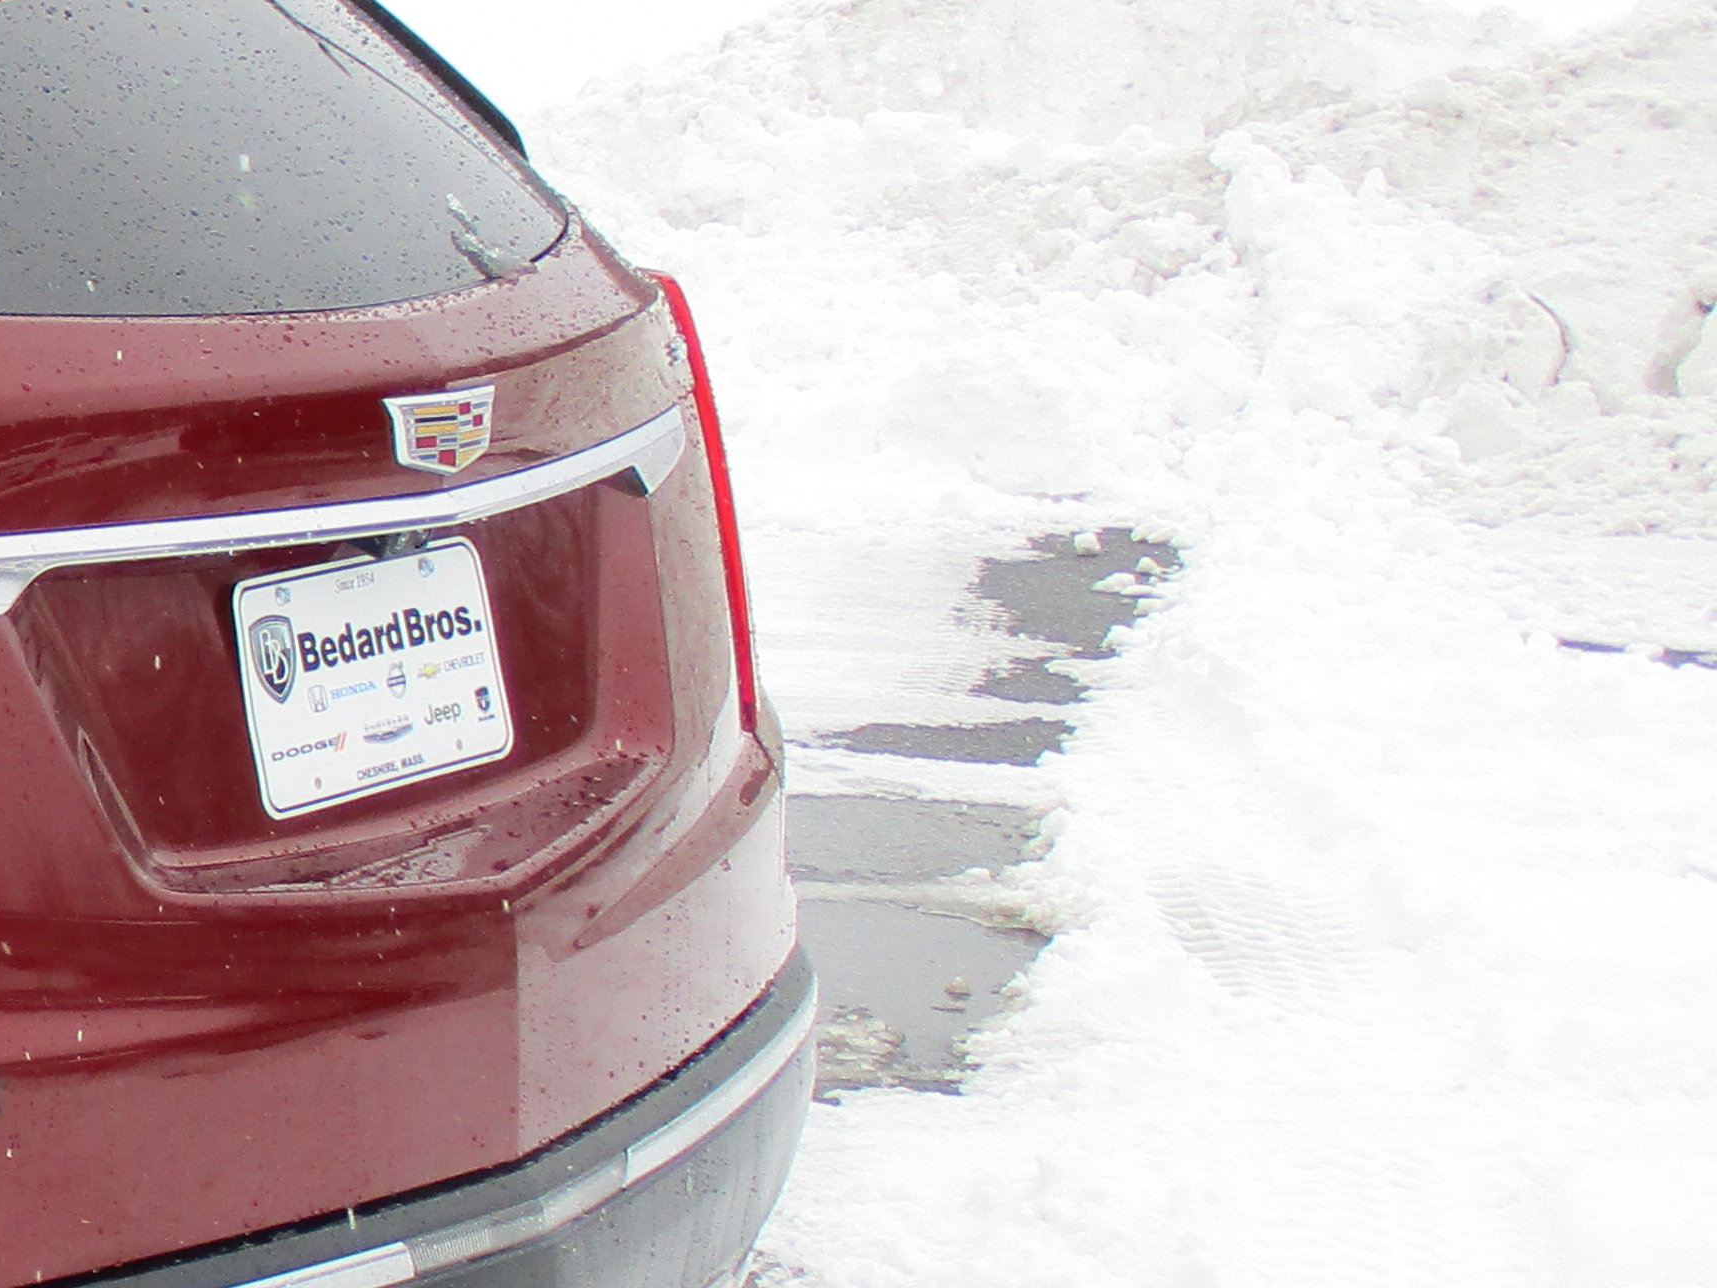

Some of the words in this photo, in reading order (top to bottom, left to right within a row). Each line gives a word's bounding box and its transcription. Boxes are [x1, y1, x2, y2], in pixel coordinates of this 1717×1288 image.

[296, 611, 405, 673] Bedard
[402, 606, 483, 648] Bros.
[330, 680, 378, 700] HONDA
[424, 701, 462, 725] Jeep
[271, 735, 339, 762] DODGE
